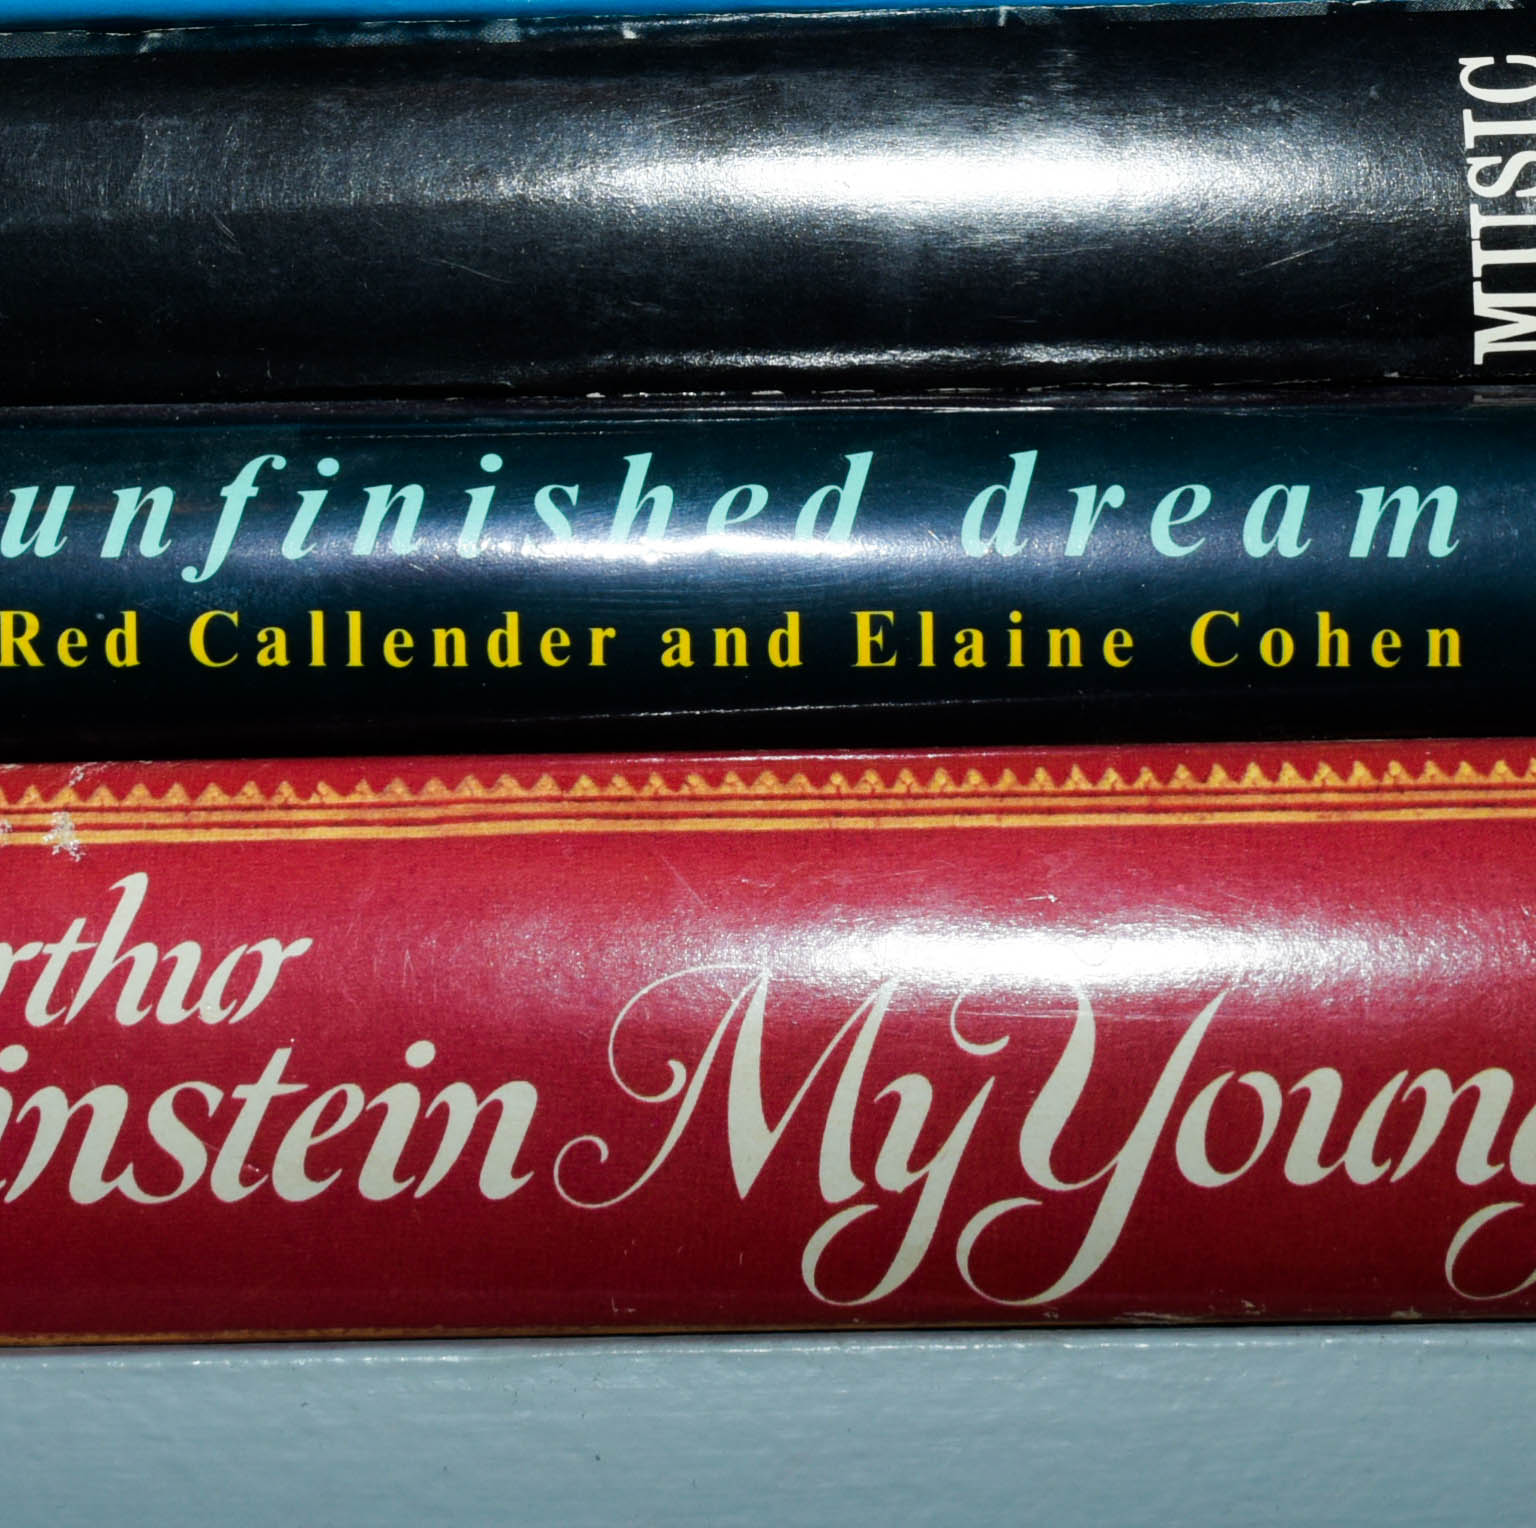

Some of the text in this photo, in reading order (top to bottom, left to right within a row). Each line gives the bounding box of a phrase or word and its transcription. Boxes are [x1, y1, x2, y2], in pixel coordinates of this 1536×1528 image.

[0, 449, 1460, 583] unfinished dream
[188, 609, 617, 668] Callender
[660, 610, 802, 668] and
[850, 610, 1134, 668] Elaine
[1190, 610, 1462, 668] Cohen
[554, 963, 996, 1306] My
